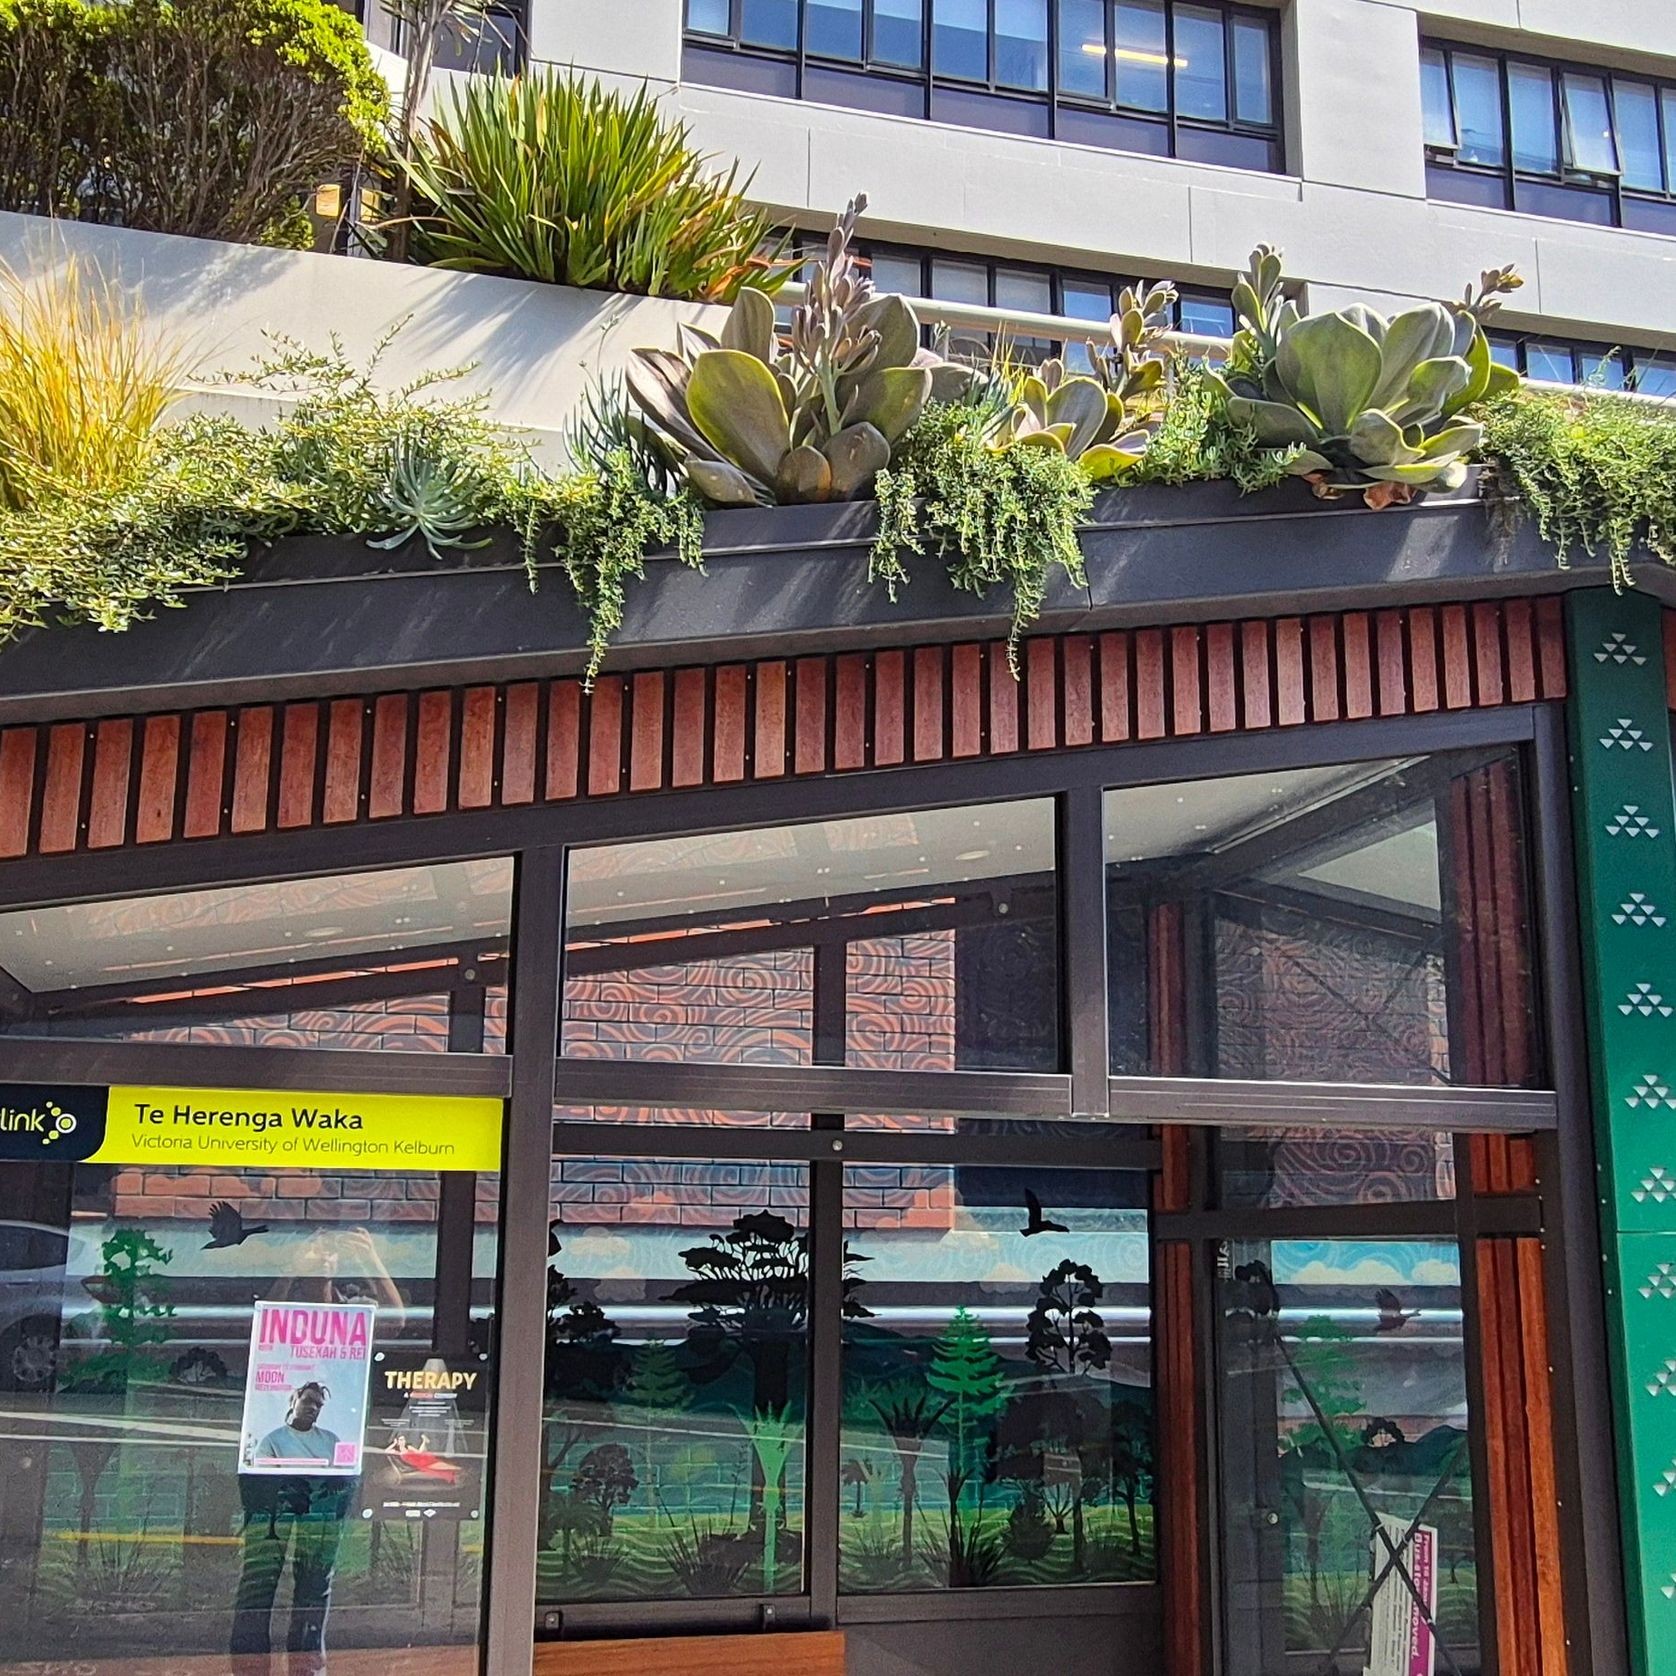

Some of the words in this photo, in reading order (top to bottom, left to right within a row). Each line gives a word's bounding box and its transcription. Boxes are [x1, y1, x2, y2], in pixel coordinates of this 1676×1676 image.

[0, 1107, 46, 1132] link
[134, 1104, 164, 1125] Te
[174, 1105, 282, 1131] Herenga
[292, 1107, 363, 1129] Waka
[131, 1133, 193, 1150] Victoria
[198, 1135, 277, 1154] University
[282, 1136, 299, 1152] of
[303, 1137, 388, 1158] Wellington
[394, 1140, 455, 1154] Kelburn
[259, 1309, 367, 1346] INDUNA
[255, 1371, 285, 1384] MOON
[384, 1371, 477, 1390] THERAPY
